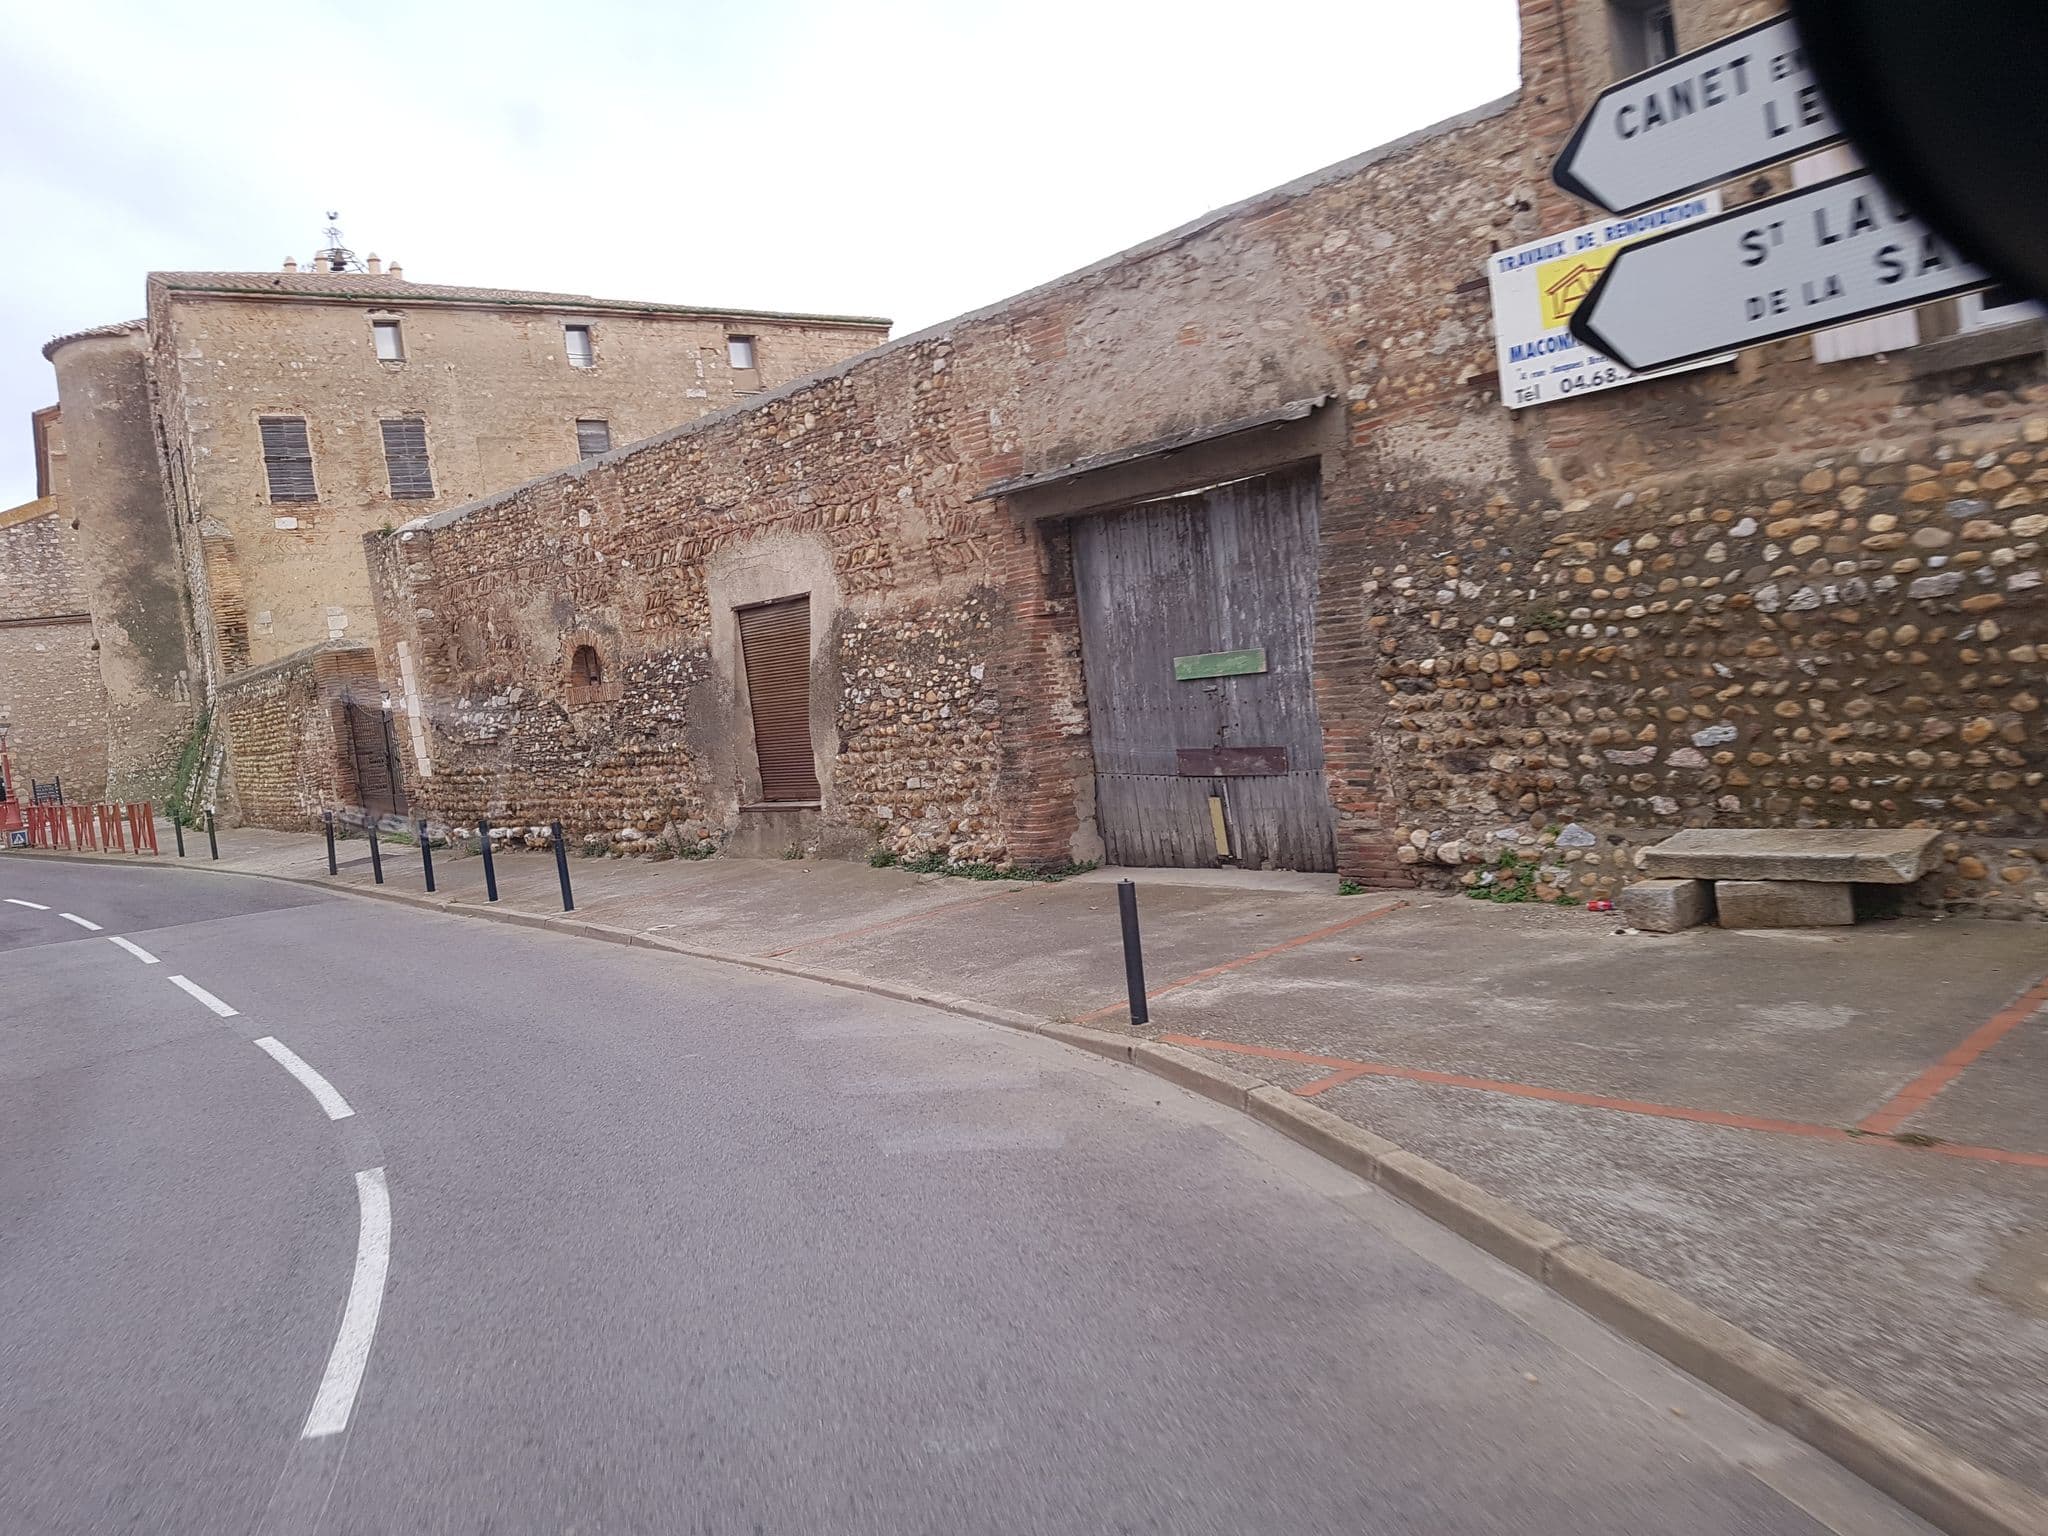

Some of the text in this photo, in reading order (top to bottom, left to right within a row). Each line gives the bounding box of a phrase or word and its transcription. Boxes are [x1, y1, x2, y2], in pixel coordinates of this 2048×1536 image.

[1614, 54, 1752, 140] CANET
[1498, 197, 1709, 274] TRAVAUX DE RENOVATION
[1745, 232, 1953, 321] DE LA SA
[1559, 366, 1634, 395] 04.68.
